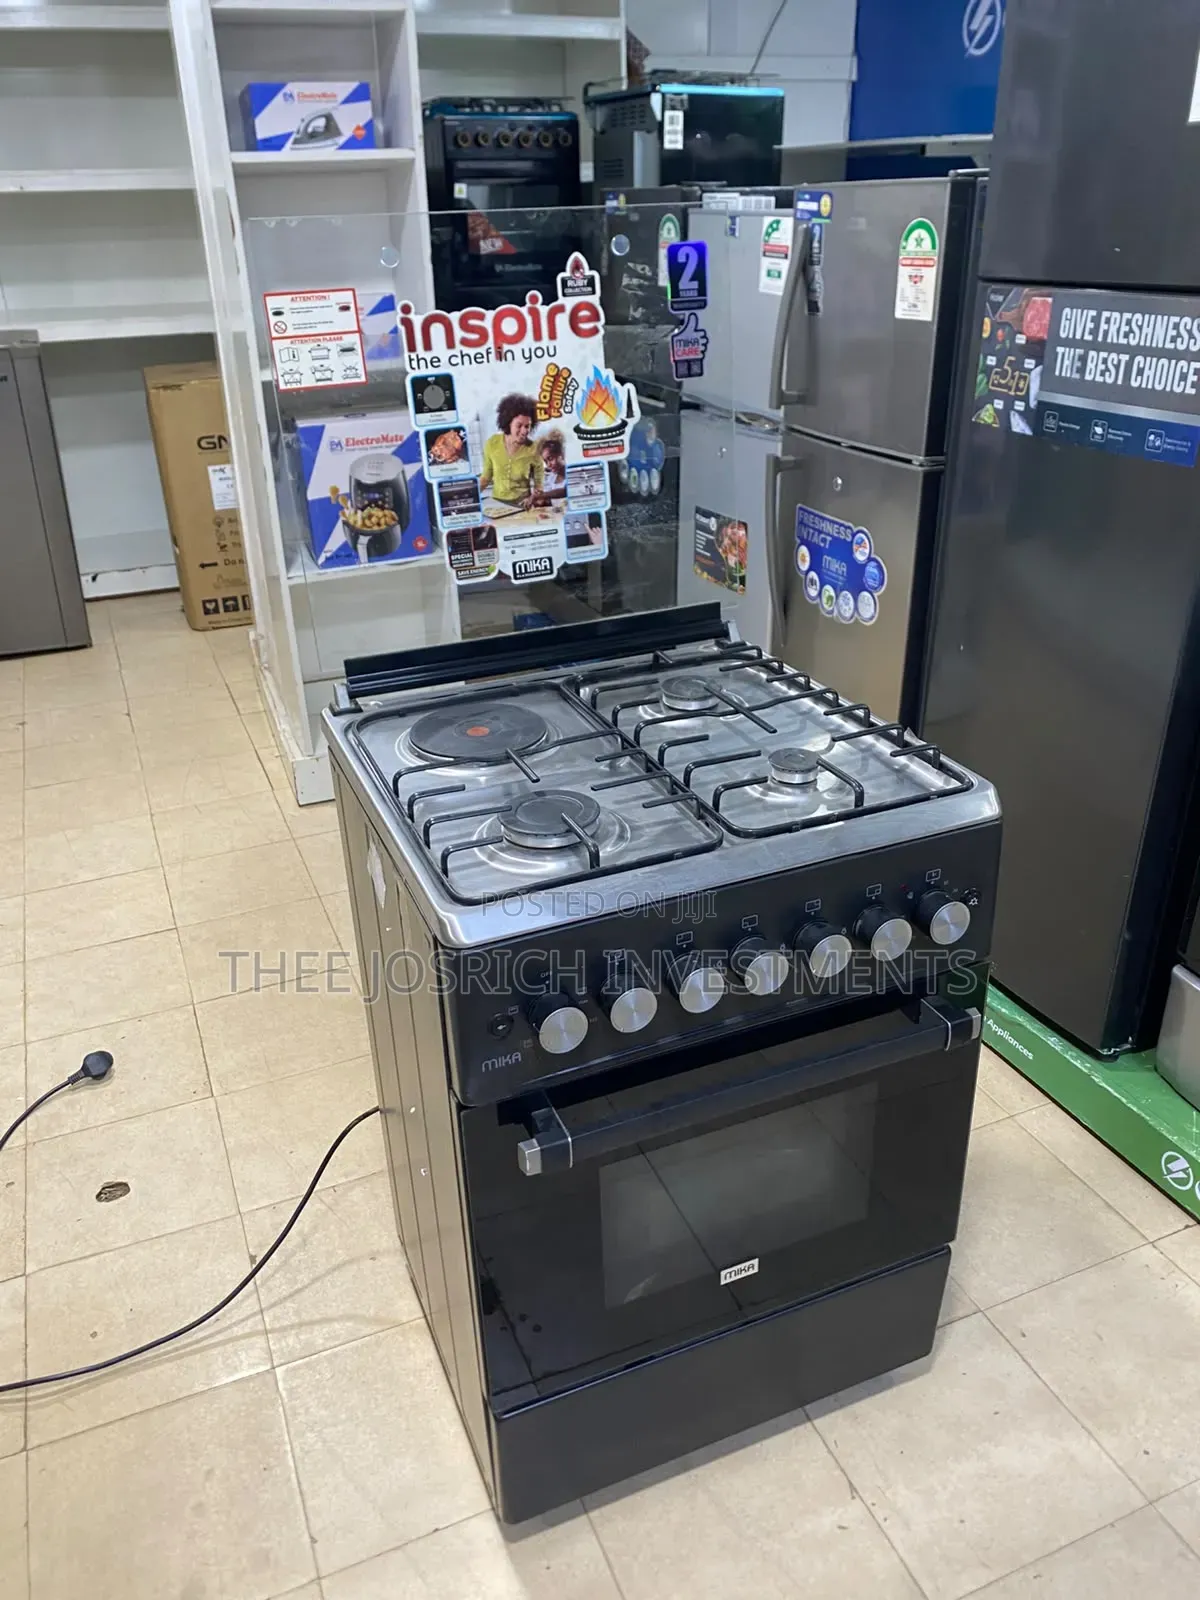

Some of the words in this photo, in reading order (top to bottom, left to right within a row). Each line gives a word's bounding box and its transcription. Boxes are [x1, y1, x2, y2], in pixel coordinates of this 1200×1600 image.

[480, 238, 503, 254] NEW
[678, 246, 699, 290] 2
[567, 279, 588, 288] RUBY
[291, 295, 327, 303] ATTENTION
[400, 293, 600, 361] inspire
[1059, 307, 1097, 341] GIVE
[1097, 310, 1200, 352] FRESHNESS
[675, 337, 700, 348] MIKA
[675, 348, 700, 357] CARE
[408, 354, 441, 370] the
[448, 349, 492, 366] chef
[497, 346, 515, 362] in
[522, 345, 557, 364] you
[1055, 346, 1084, 379] THE
[1084, 350, 1130, 385] BEST
[1130, 355, 1200, 395] CHOICE
[537, 363, 559, 420] Flame
[551, 367, 571, 418] Failure
[564, 377, 579, 413] Safety
[345, 433, 404, 447] ElectroMate
[799, 510, 852, 542] FRESHNESS
[799, 524, 832, 549] INTACT
[516, 558, 550, 574] MIKA
[822, 555, 847, 576] MIKA
[987, 1018, 1034, 1061] Appliances
[482, 1052, 522, 1072] MIKA
[724, 1263, 755, 1280] MIKA
